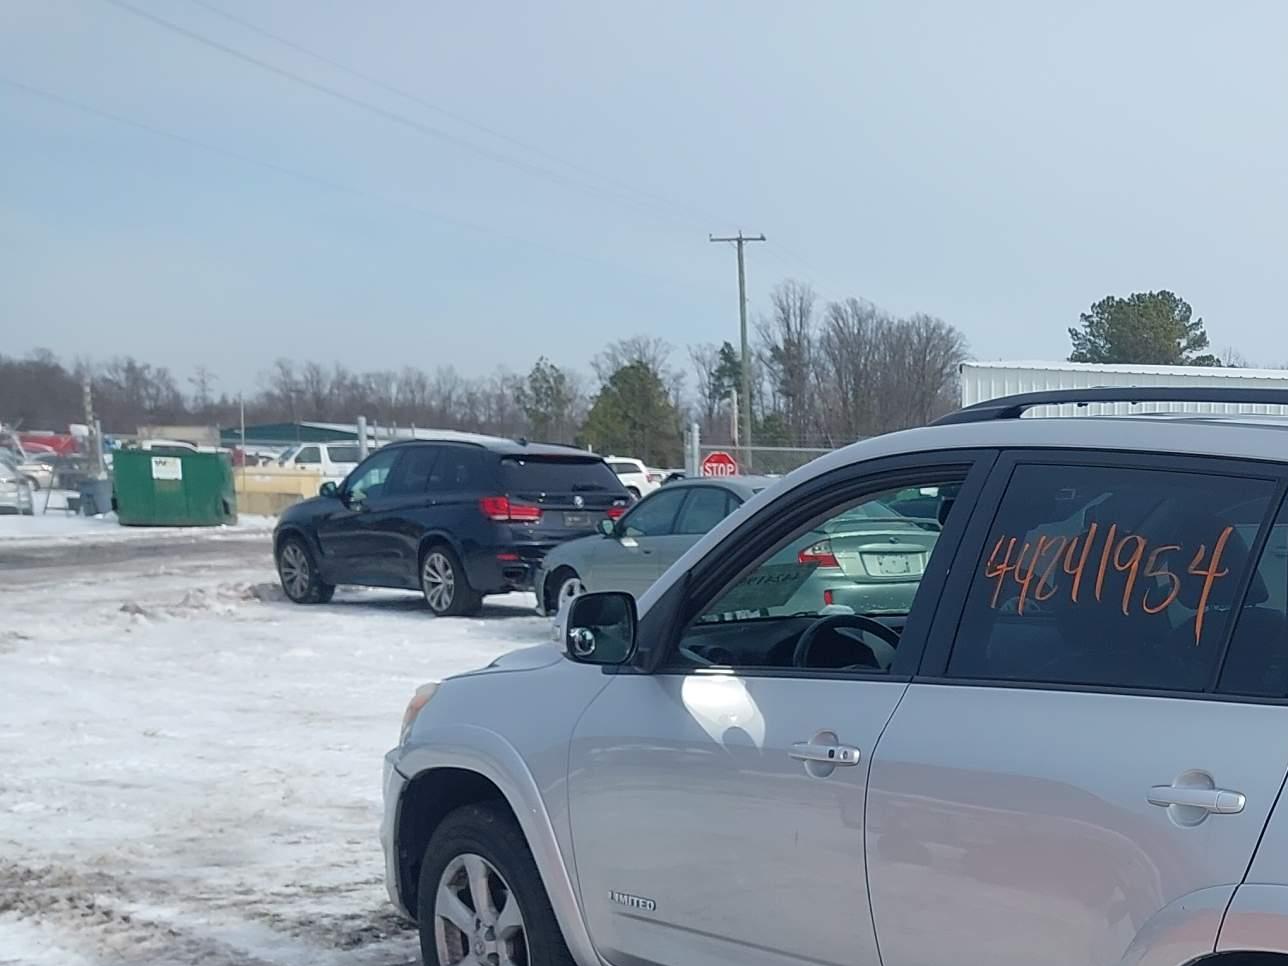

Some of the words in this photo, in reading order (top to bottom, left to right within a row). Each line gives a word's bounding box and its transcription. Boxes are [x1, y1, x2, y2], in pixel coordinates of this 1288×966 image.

[704, 463, 735, 477] STOP
[985, 523, 1233, 647] 44241954
[608, 891, 656, 912] LIMITED
